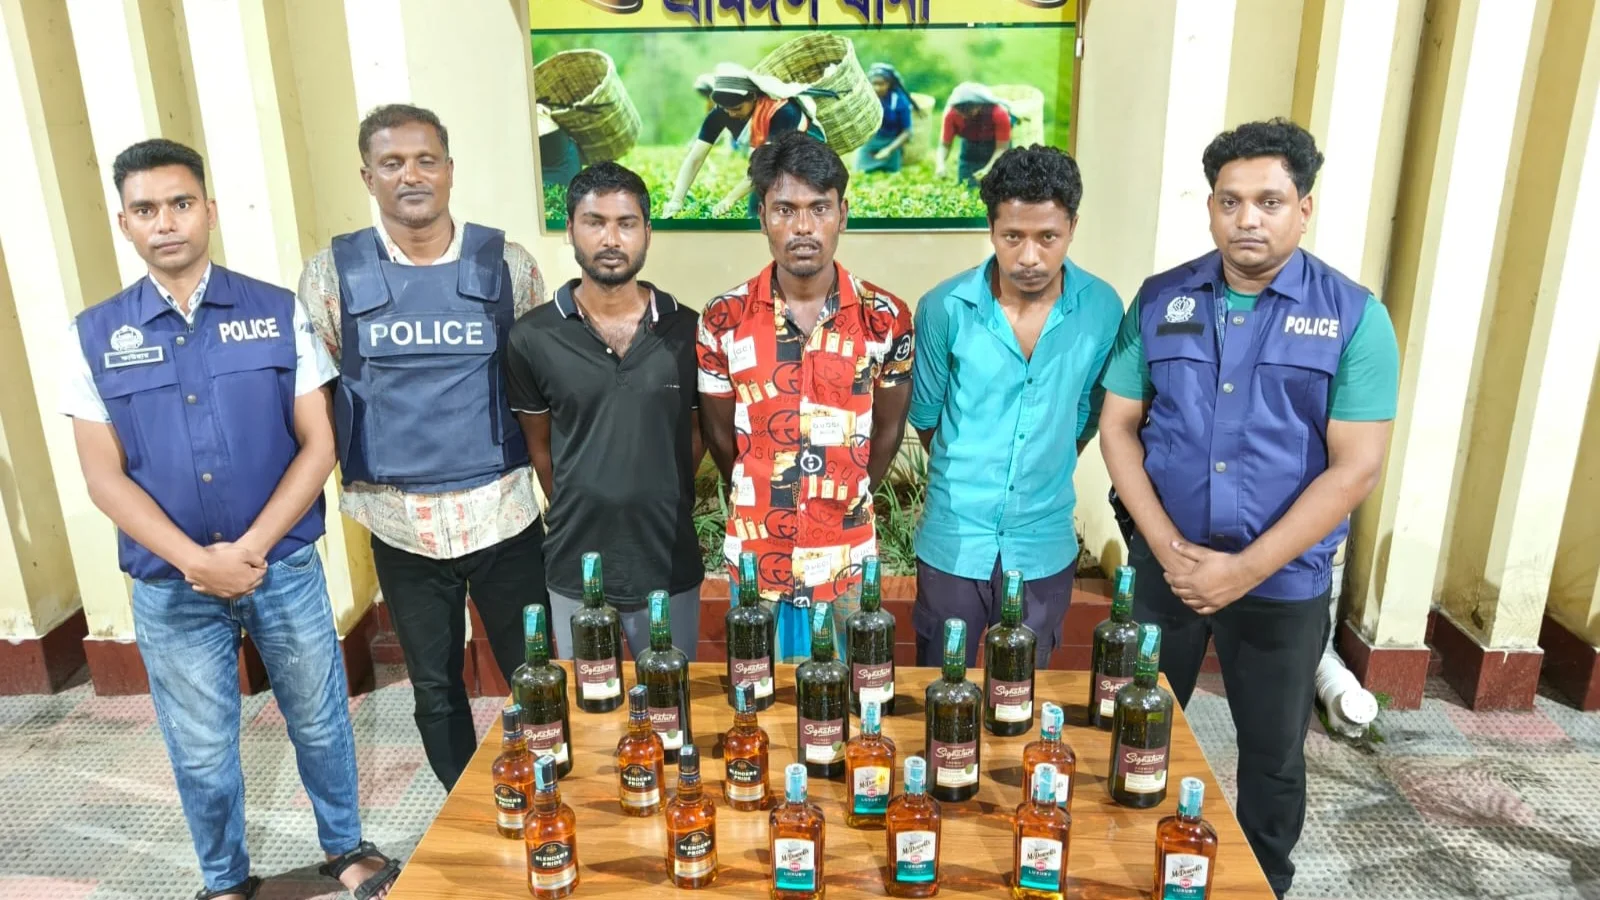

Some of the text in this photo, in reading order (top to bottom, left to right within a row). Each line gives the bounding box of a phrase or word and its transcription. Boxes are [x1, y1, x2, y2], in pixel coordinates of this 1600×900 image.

[219, 318, 280, 343] POLICE
[370, 320, 483, 347] POLICE
[1284, 315, 1340, 338] POLICE
[935, 747, 976, 760] Signature
[1124, 752, 1165, 765] Signature
